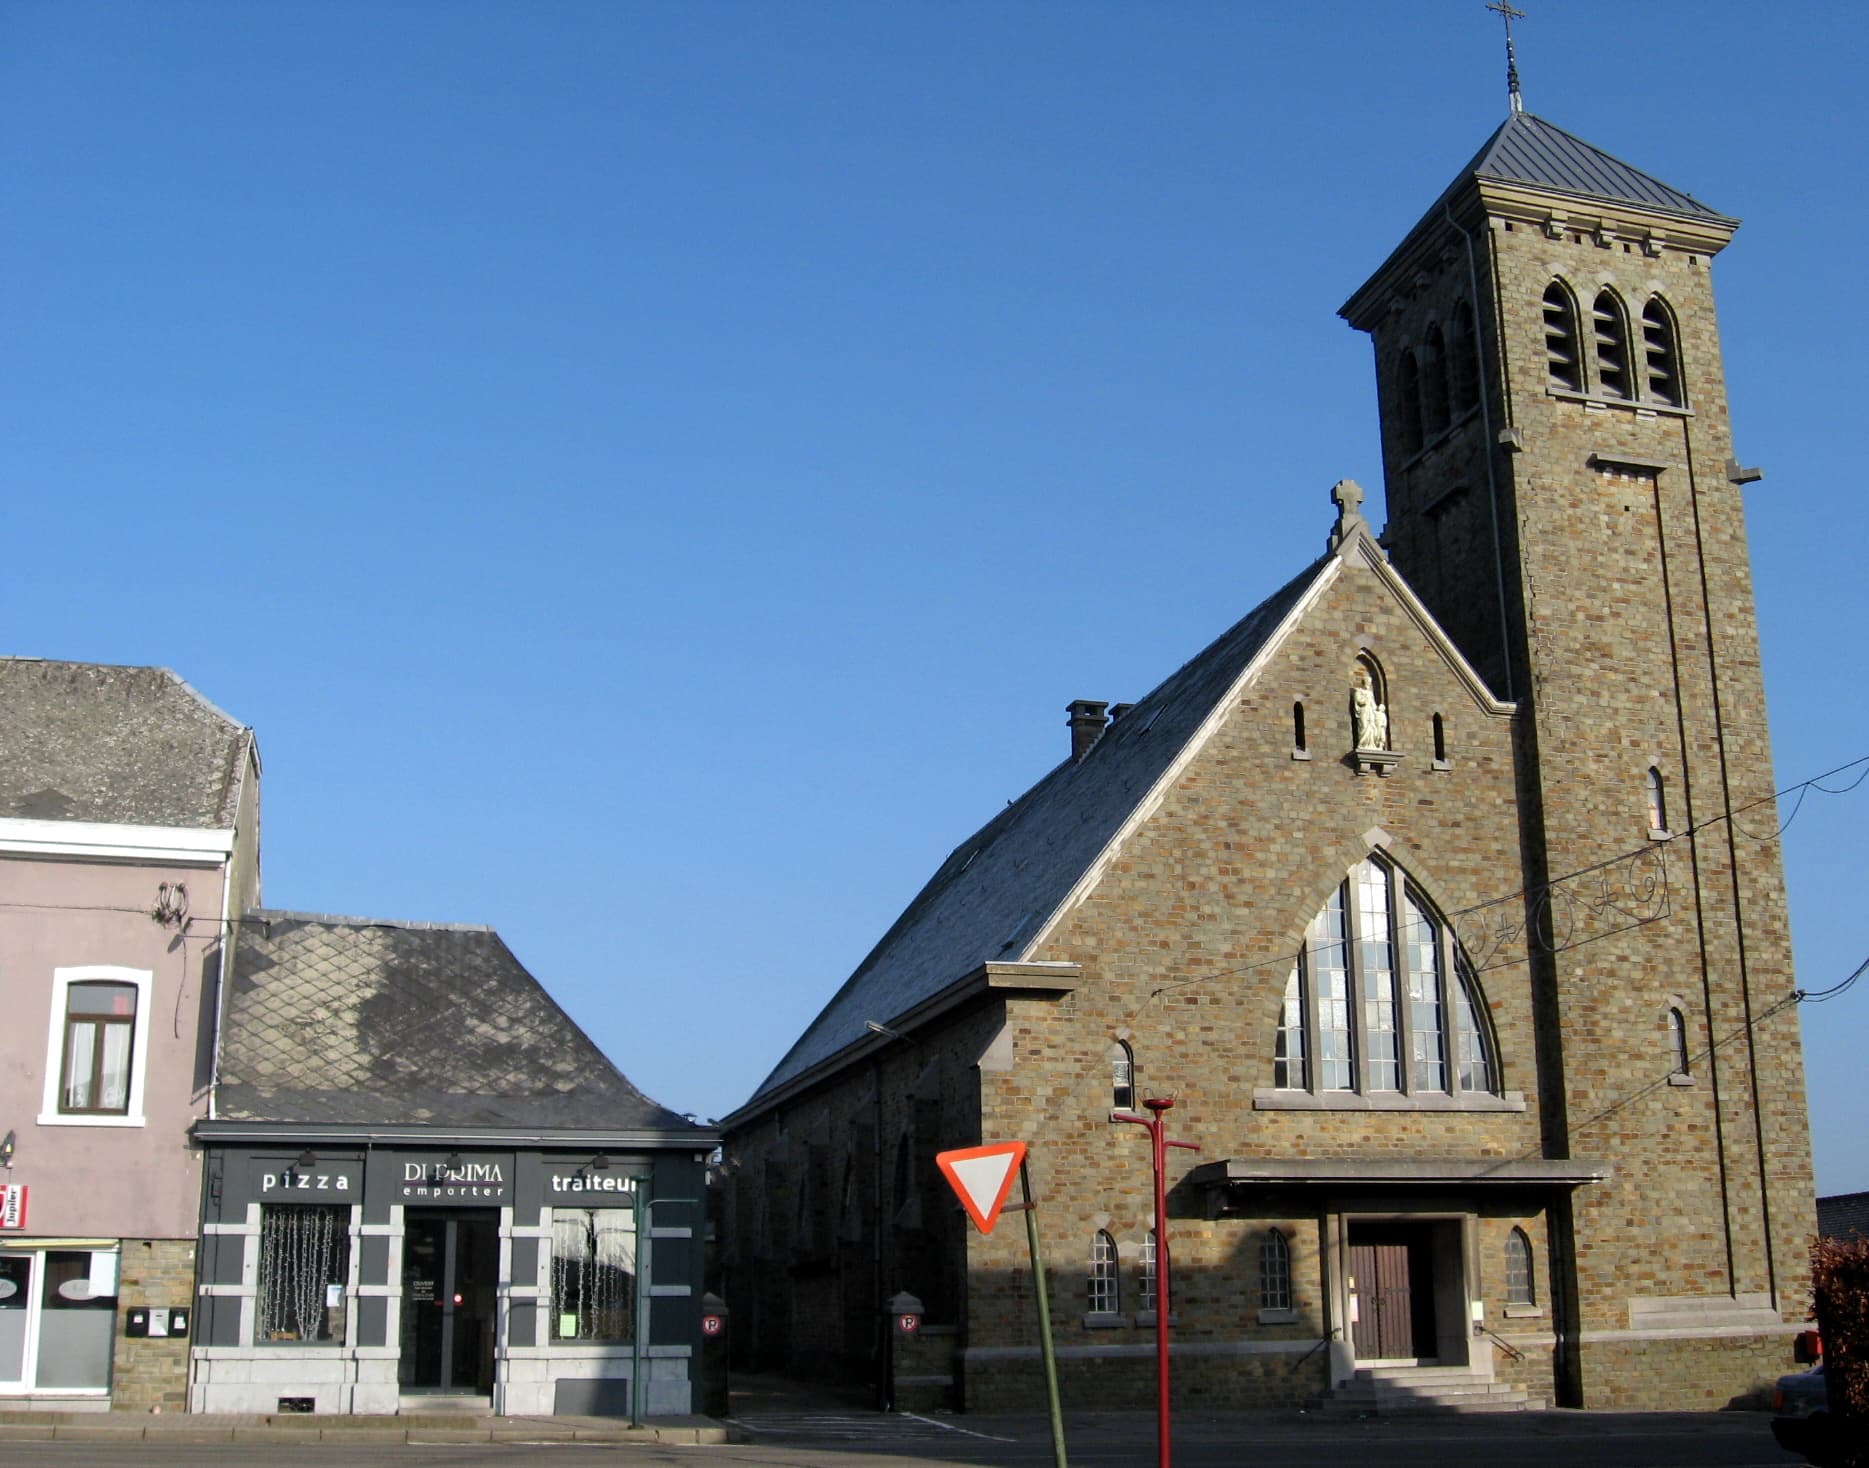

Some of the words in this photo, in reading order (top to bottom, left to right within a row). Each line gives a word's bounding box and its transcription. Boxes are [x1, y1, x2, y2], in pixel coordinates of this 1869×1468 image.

[404, 1163, 427, 1181] DI
[434, 1163, 504, 1182] PRIMA
[262, 1170, 349, 1193] pizza
[403, 1186, 504, 1198] emporter
[708, 1319, 717, 1330] P
[905, 1317, 914, 1329] P
